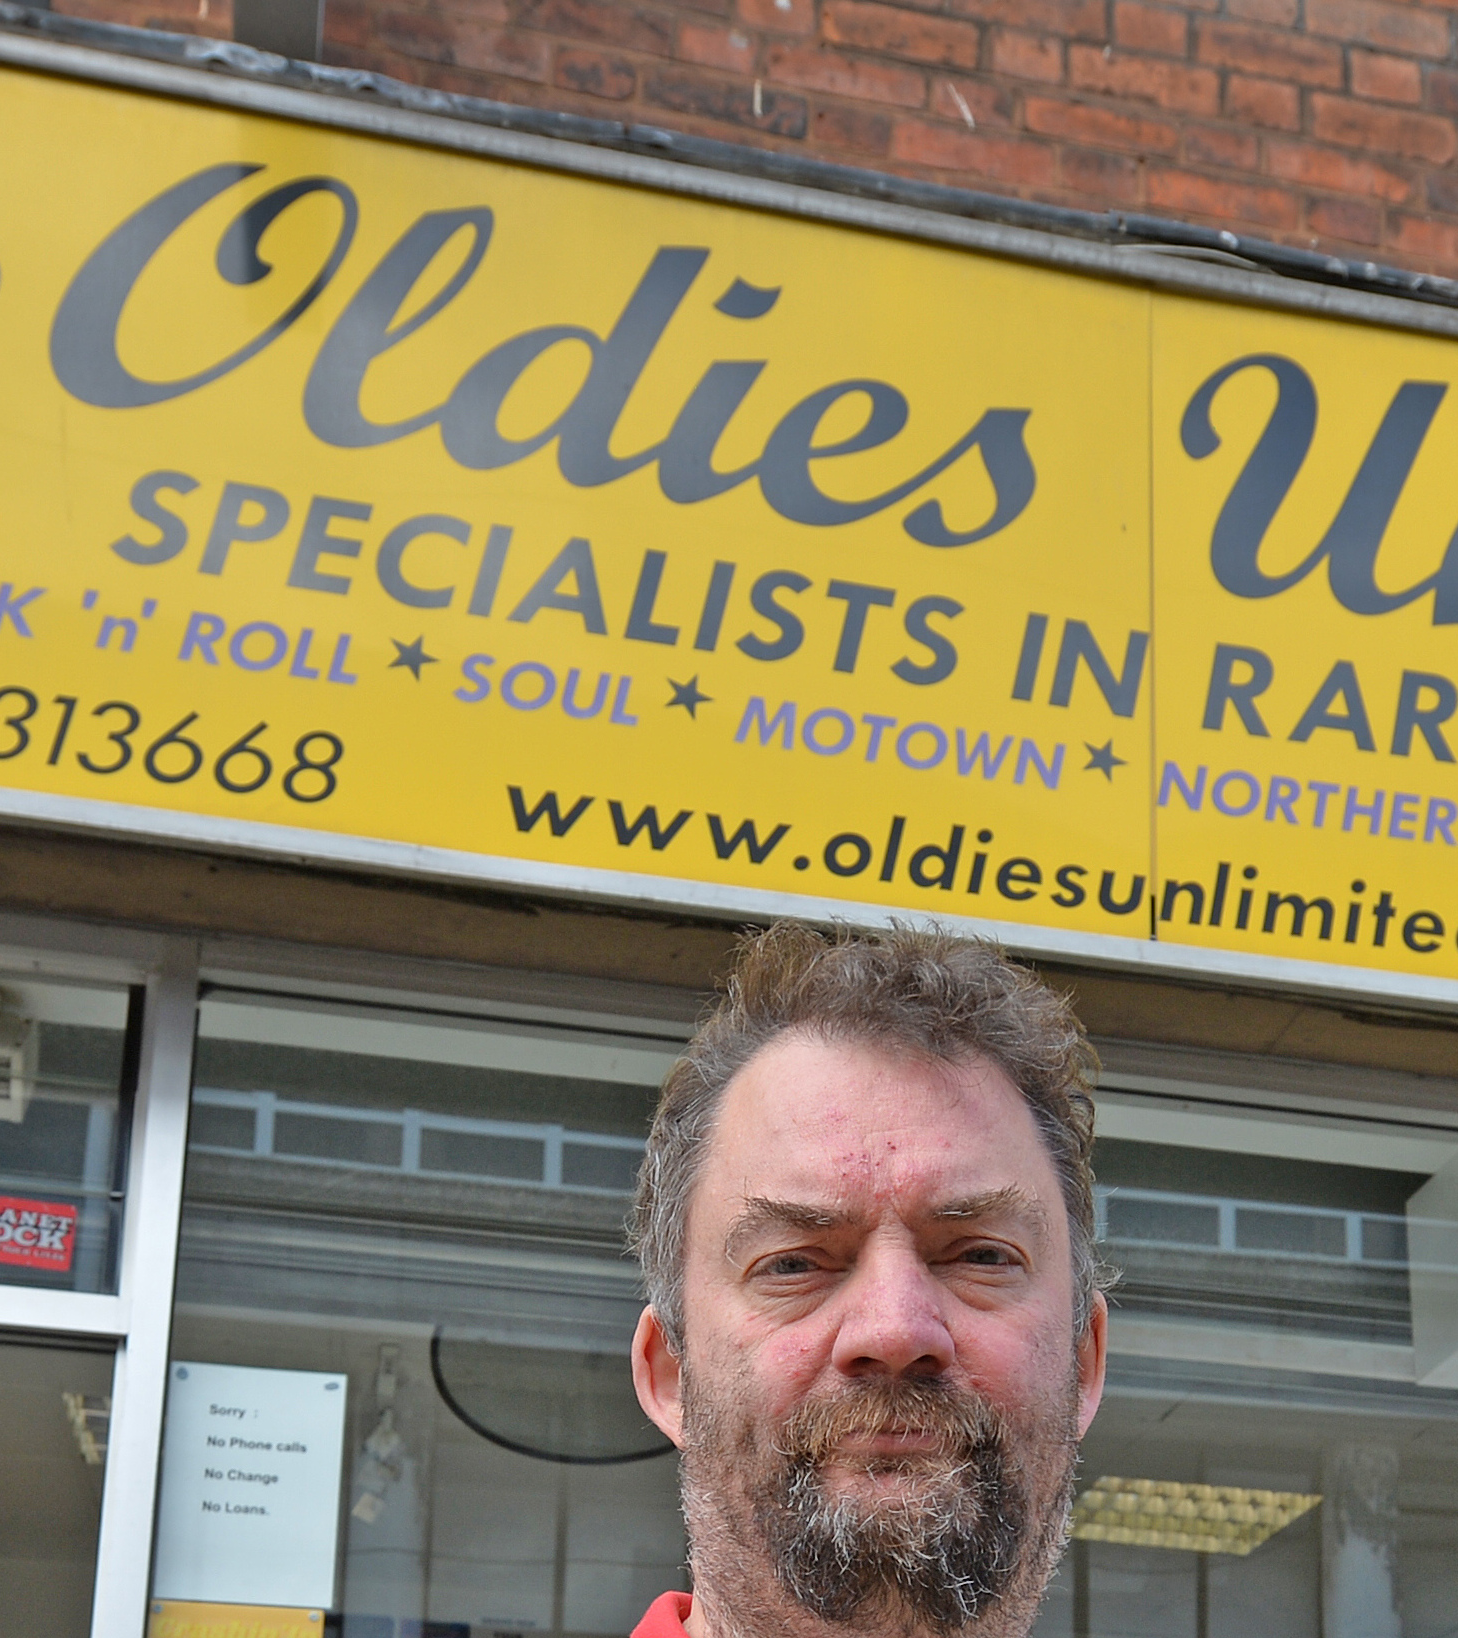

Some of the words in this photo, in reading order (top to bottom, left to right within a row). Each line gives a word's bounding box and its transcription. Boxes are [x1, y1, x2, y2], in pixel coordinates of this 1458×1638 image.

[49, 162, 1036, 547] Oldies
[110, 469, 966, 686] SPECIALISTS
[1010, 612, 1149, 720] IN
[81, 591, 157, 653] 'n'
[178, 611, 359, 685] ROLL
[454, 652, 640, 728] SOUL
[733, 696, 1067, 791] MOTOWN
[209, 1403, 246, 1419] Sorry
[206, 1435, 225, 1448] No
[229, 1437, 272, 1451] Phone
[276, 1442, 307, 1453] calls
[204, 1467, 223, 1479] No
[227, 1468, 278, 1485] Change
[202, 1500, 221, 1512] No
[225, 1502, 270, 1515] Loans.
